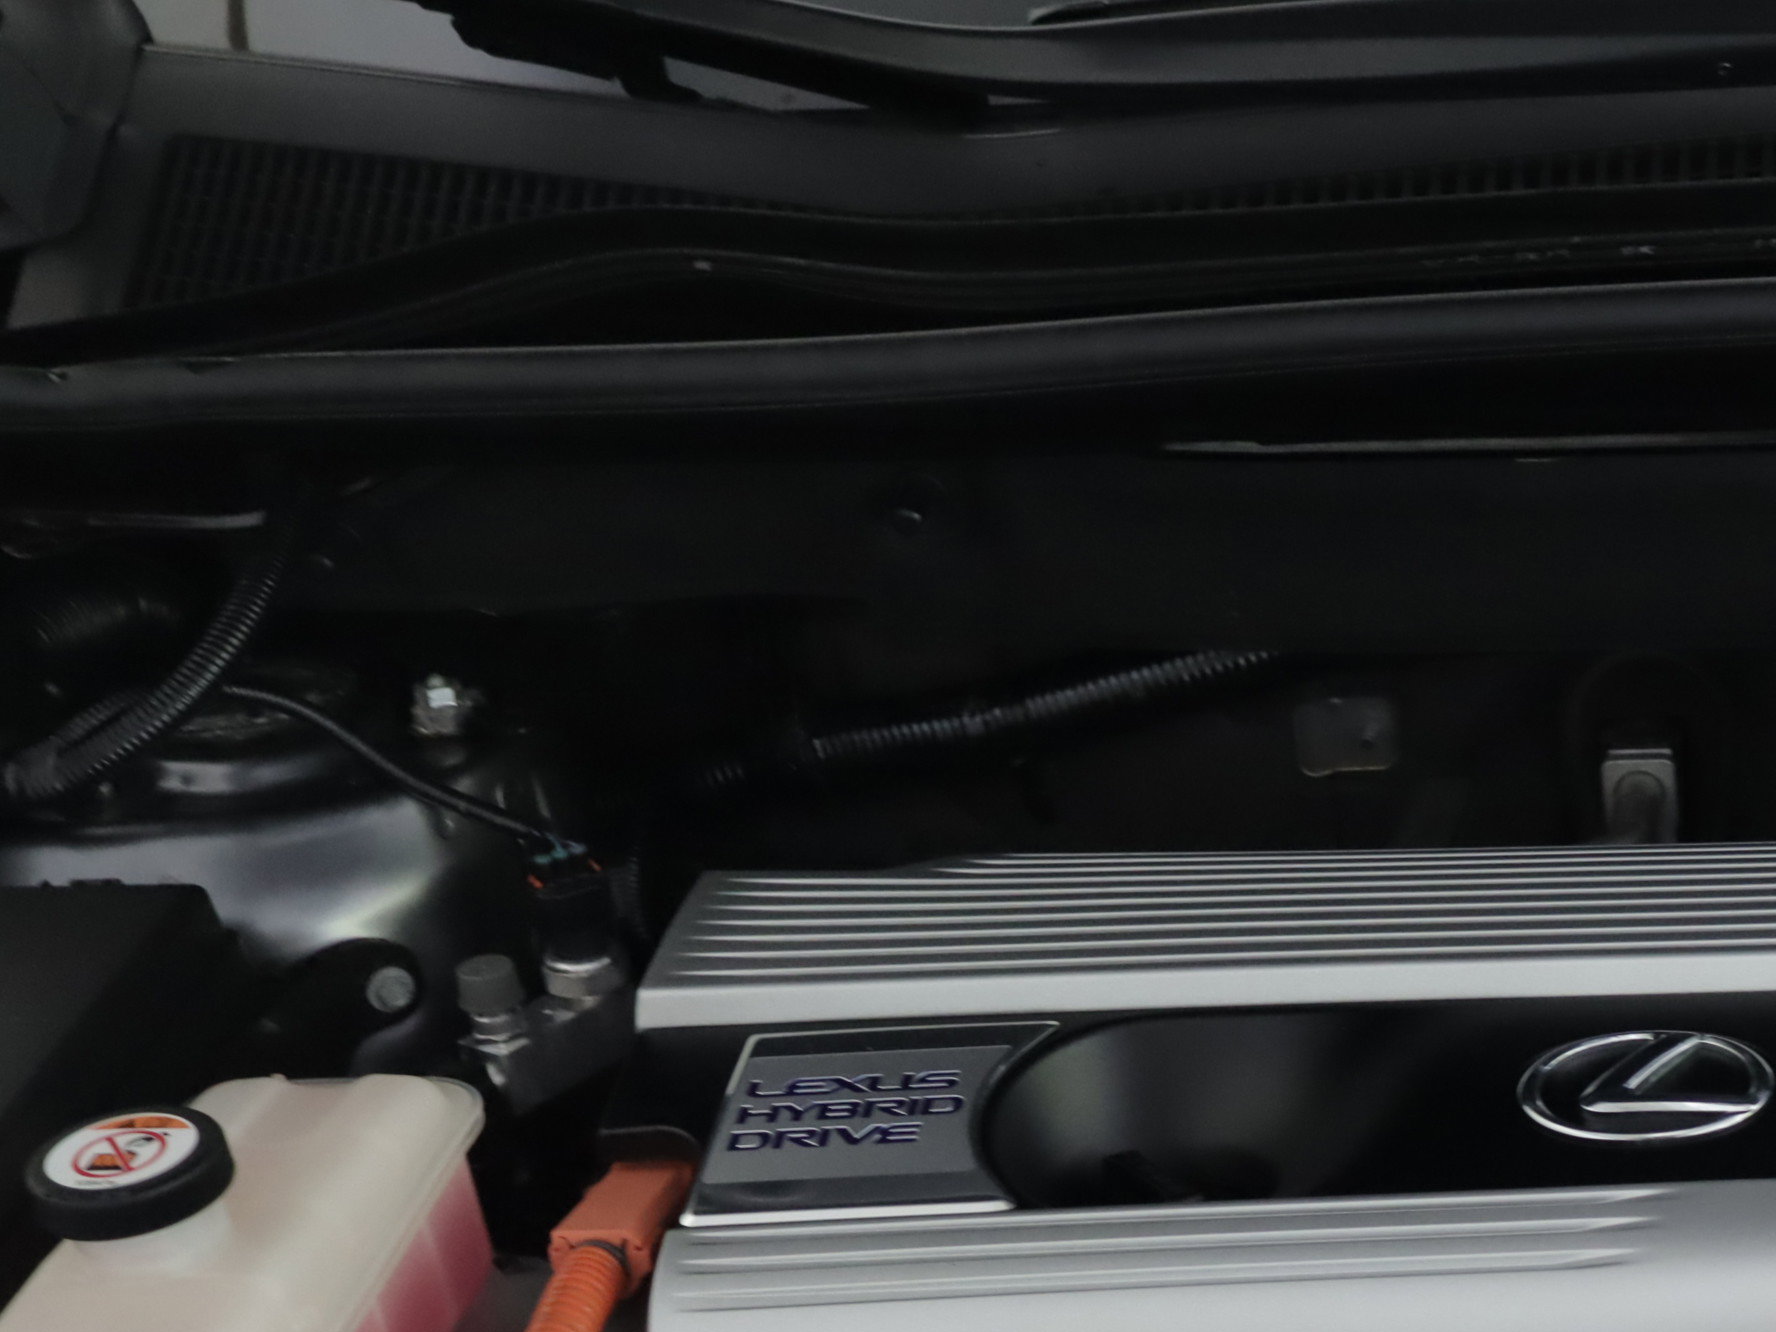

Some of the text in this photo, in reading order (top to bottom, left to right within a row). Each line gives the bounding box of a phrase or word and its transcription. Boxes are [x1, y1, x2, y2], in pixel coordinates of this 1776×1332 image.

[748, 1070, 962, 1097] LEXUS
[738, 1095, 964, 1123] HYBRID
[727, 1121, 924, 1151] DRIVE
